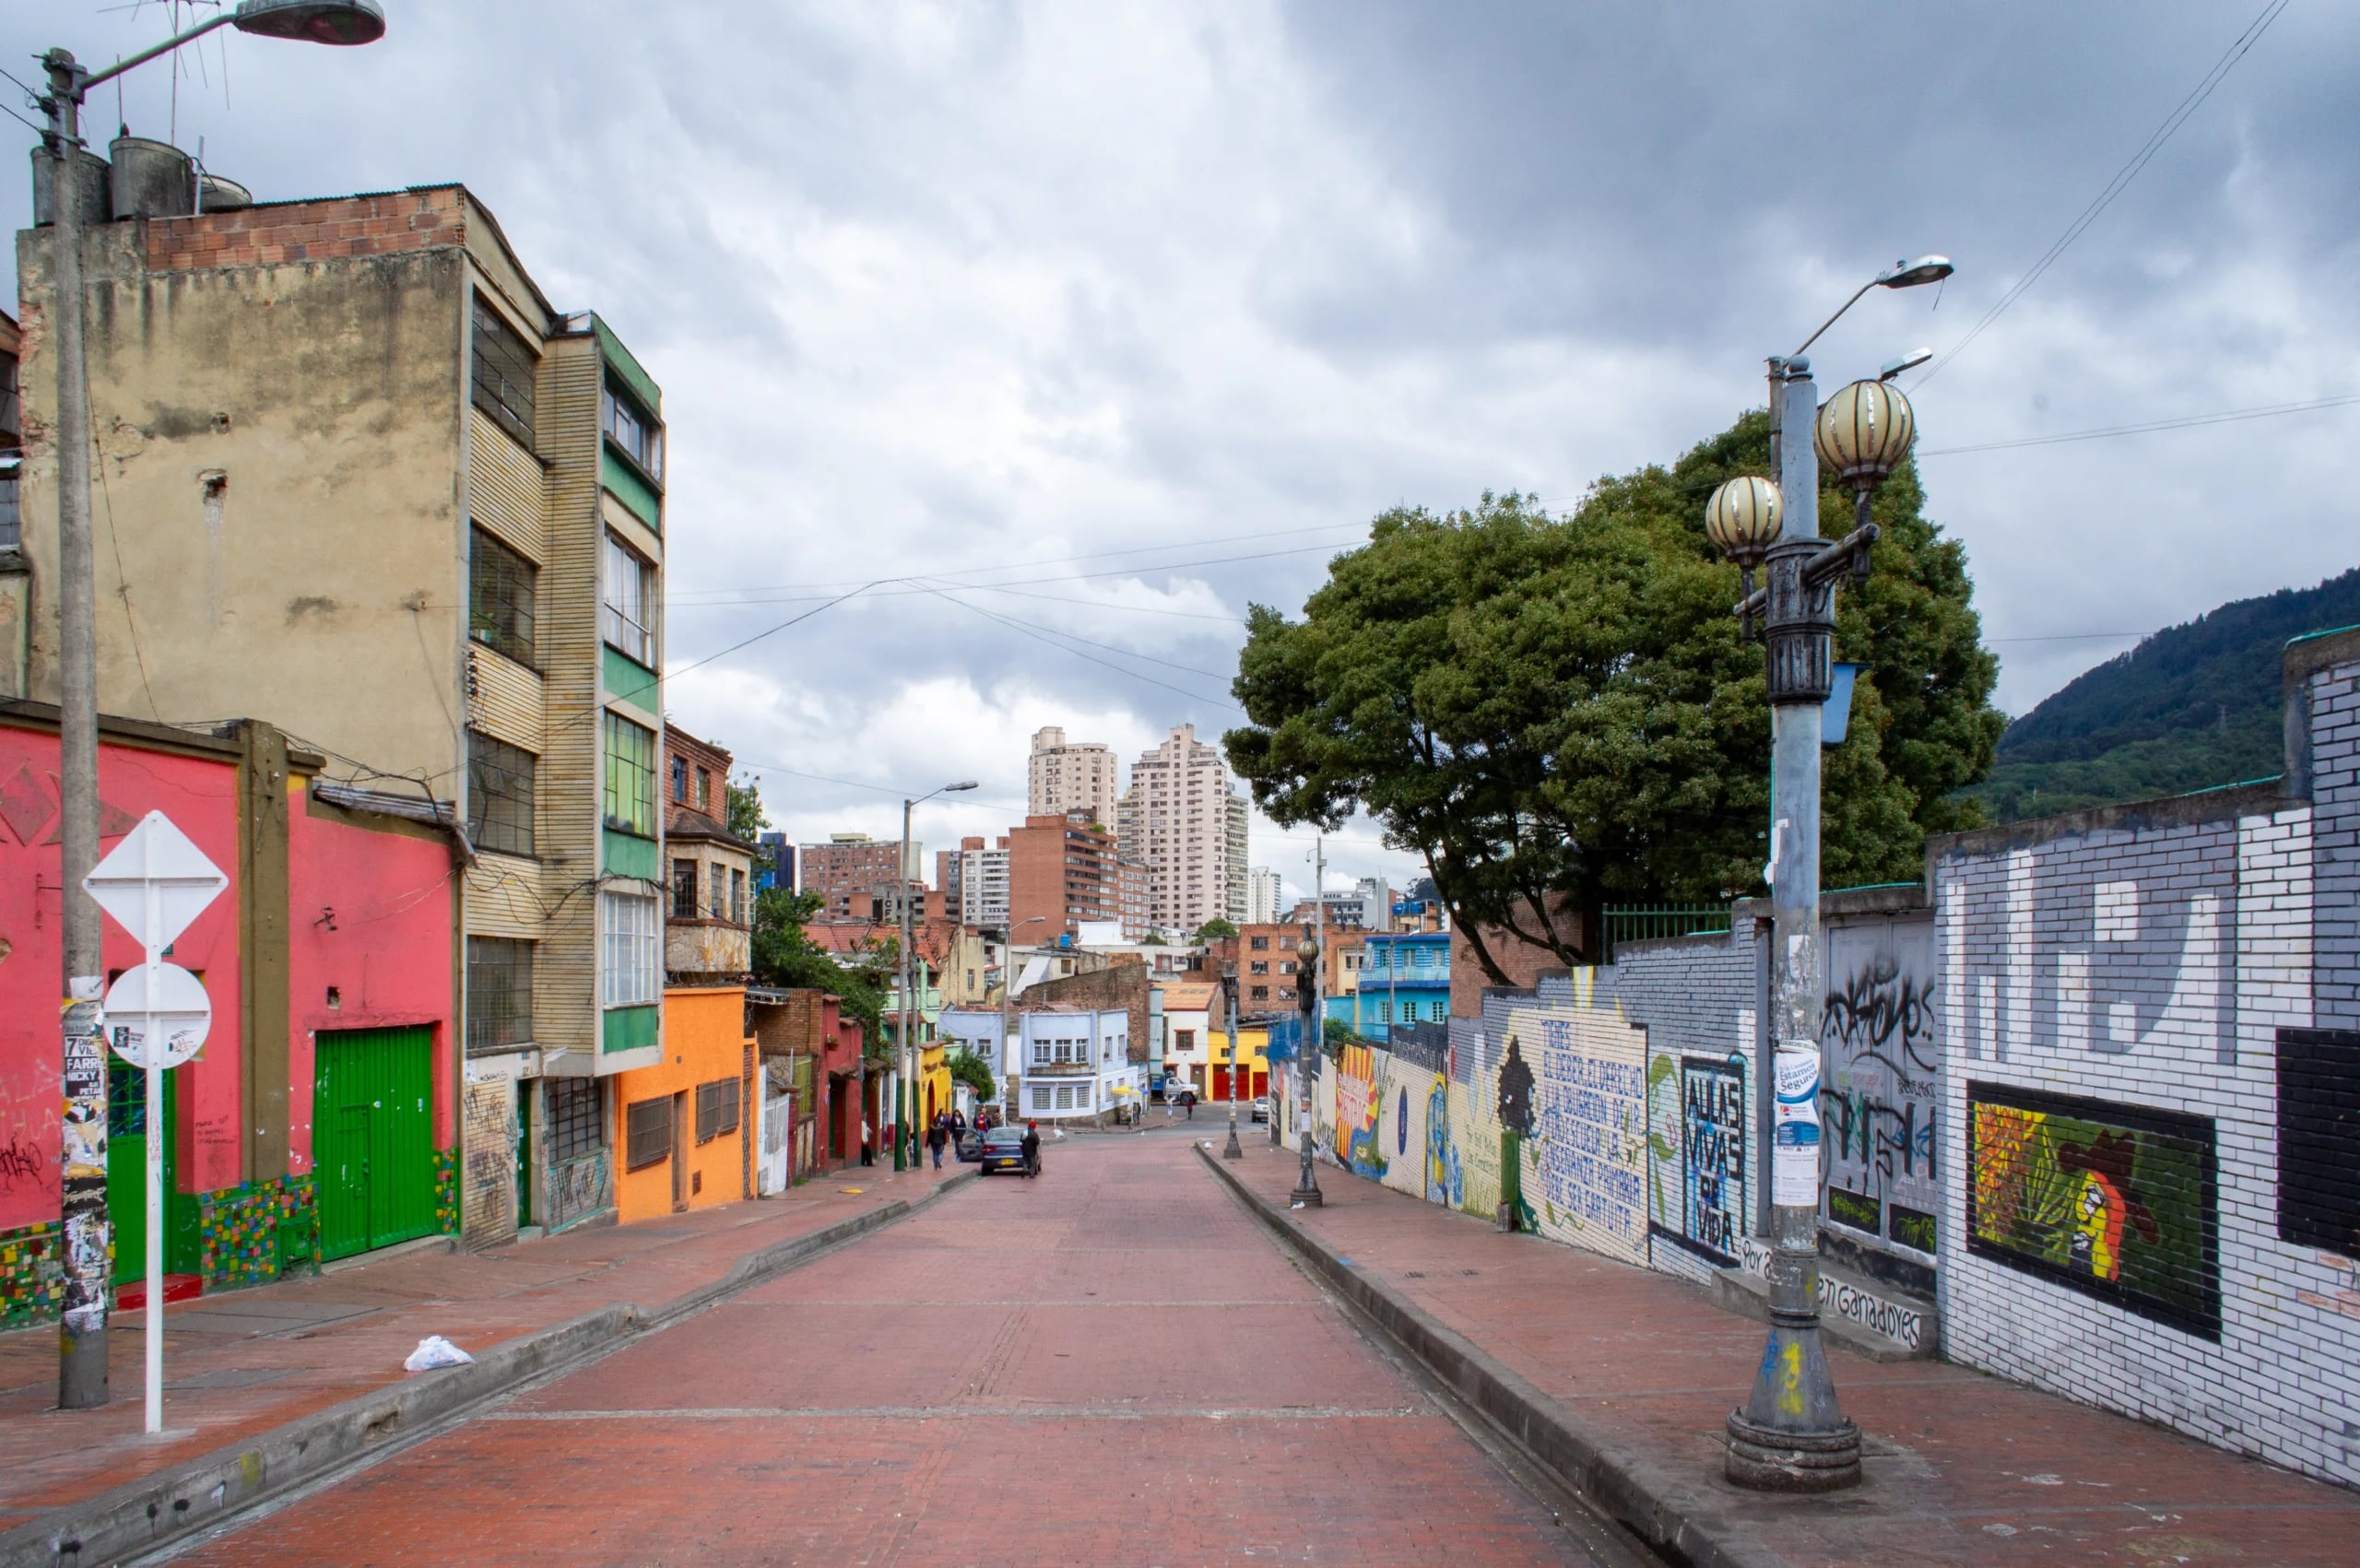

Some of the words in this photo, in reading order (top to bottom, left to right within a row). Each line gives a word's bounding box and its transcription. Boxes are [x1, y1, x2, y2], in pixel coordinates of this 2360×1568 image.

[66, 1038, 77, 1055] 7
[1543, 1050, 1552, 1078] EL
[1599, 1060, 1642, 1099] DERECHO
[1780, 1063, 1815, 1080] Estamos
[1781, 1070, 1818, 1091] Seguros
[1688, 1078, 1740, 1126] AULAS
[1686, 1124, 1740, 1180] VIVAS
[1700, 1173, 1719, 1209] DE
[1697, 1201, 1736, 1253] VIDA
